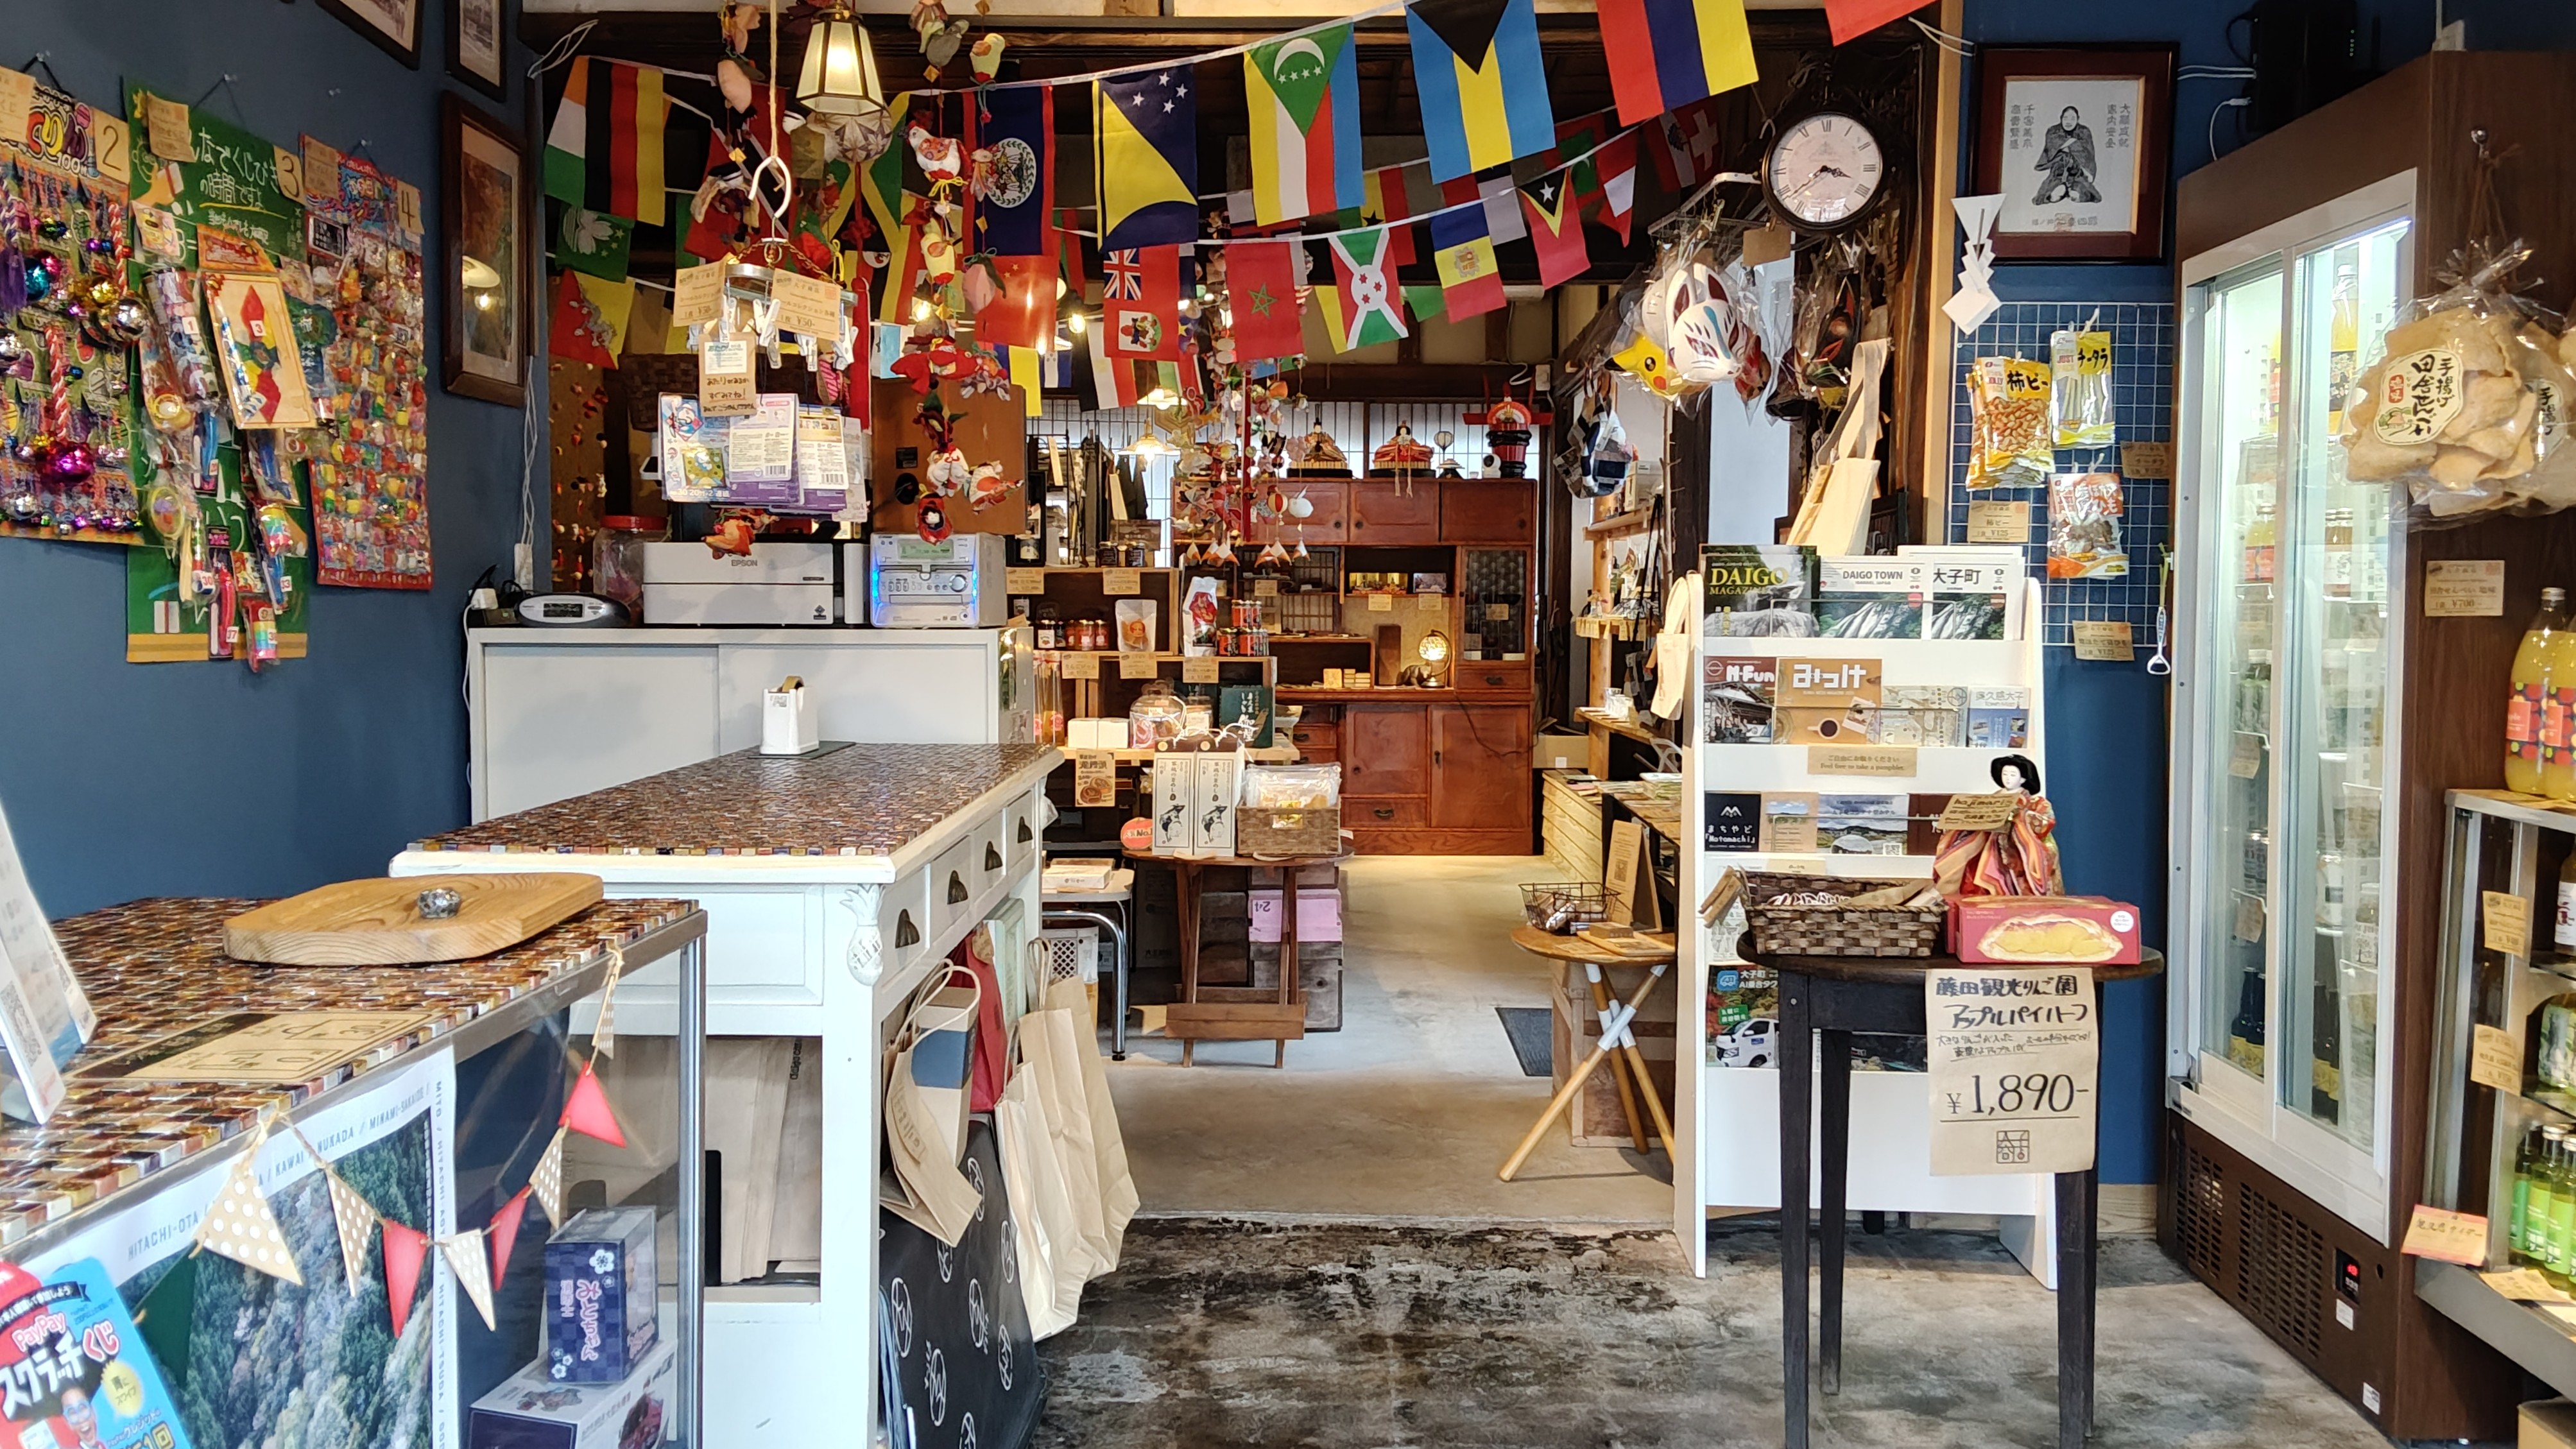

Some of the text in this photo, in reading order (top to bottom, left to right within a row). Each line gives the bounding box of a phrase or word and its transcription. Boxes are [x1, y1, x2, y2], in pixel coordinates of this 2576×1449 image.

[103, 125, 122, 171] 2
[282, 155, 300, 198] 3
[402, 190, 415, 228] 4
[2077, 348, 2109, 369] チータラ
[2007, 369, 2048, 392] 柿ピー
[2411, 354, 2436, 436] 田舎せんべい
[2435, 357, 2455, 407] 手揚げ
[1710, 567, 1789, 585] DAIGO
[1842, 570, 1903, 580] DAIGO TOWN
[1933, 568, 1982, 585] 大子町
[1708, 825, 1753, 834] まちやど
[1740, 970, 1766, 979] 大子町
[1936, 975, 2078, 997] 藤田観光りんご園
[1944, 1004, 2088, 1029] アップルパイハーフ
[1946, 1074, 2090, 1115] ¥1,890-
[128, 1215, 199, 1261] HITACHI-OTA
[275, 1155, 304, 1178] KAWAI
[12, 1312, 67, 1353] PayPay
[576, 1279, 603, 1361] みとちゃん
[0, 1319, 120, 1421] スクラッチくじ
